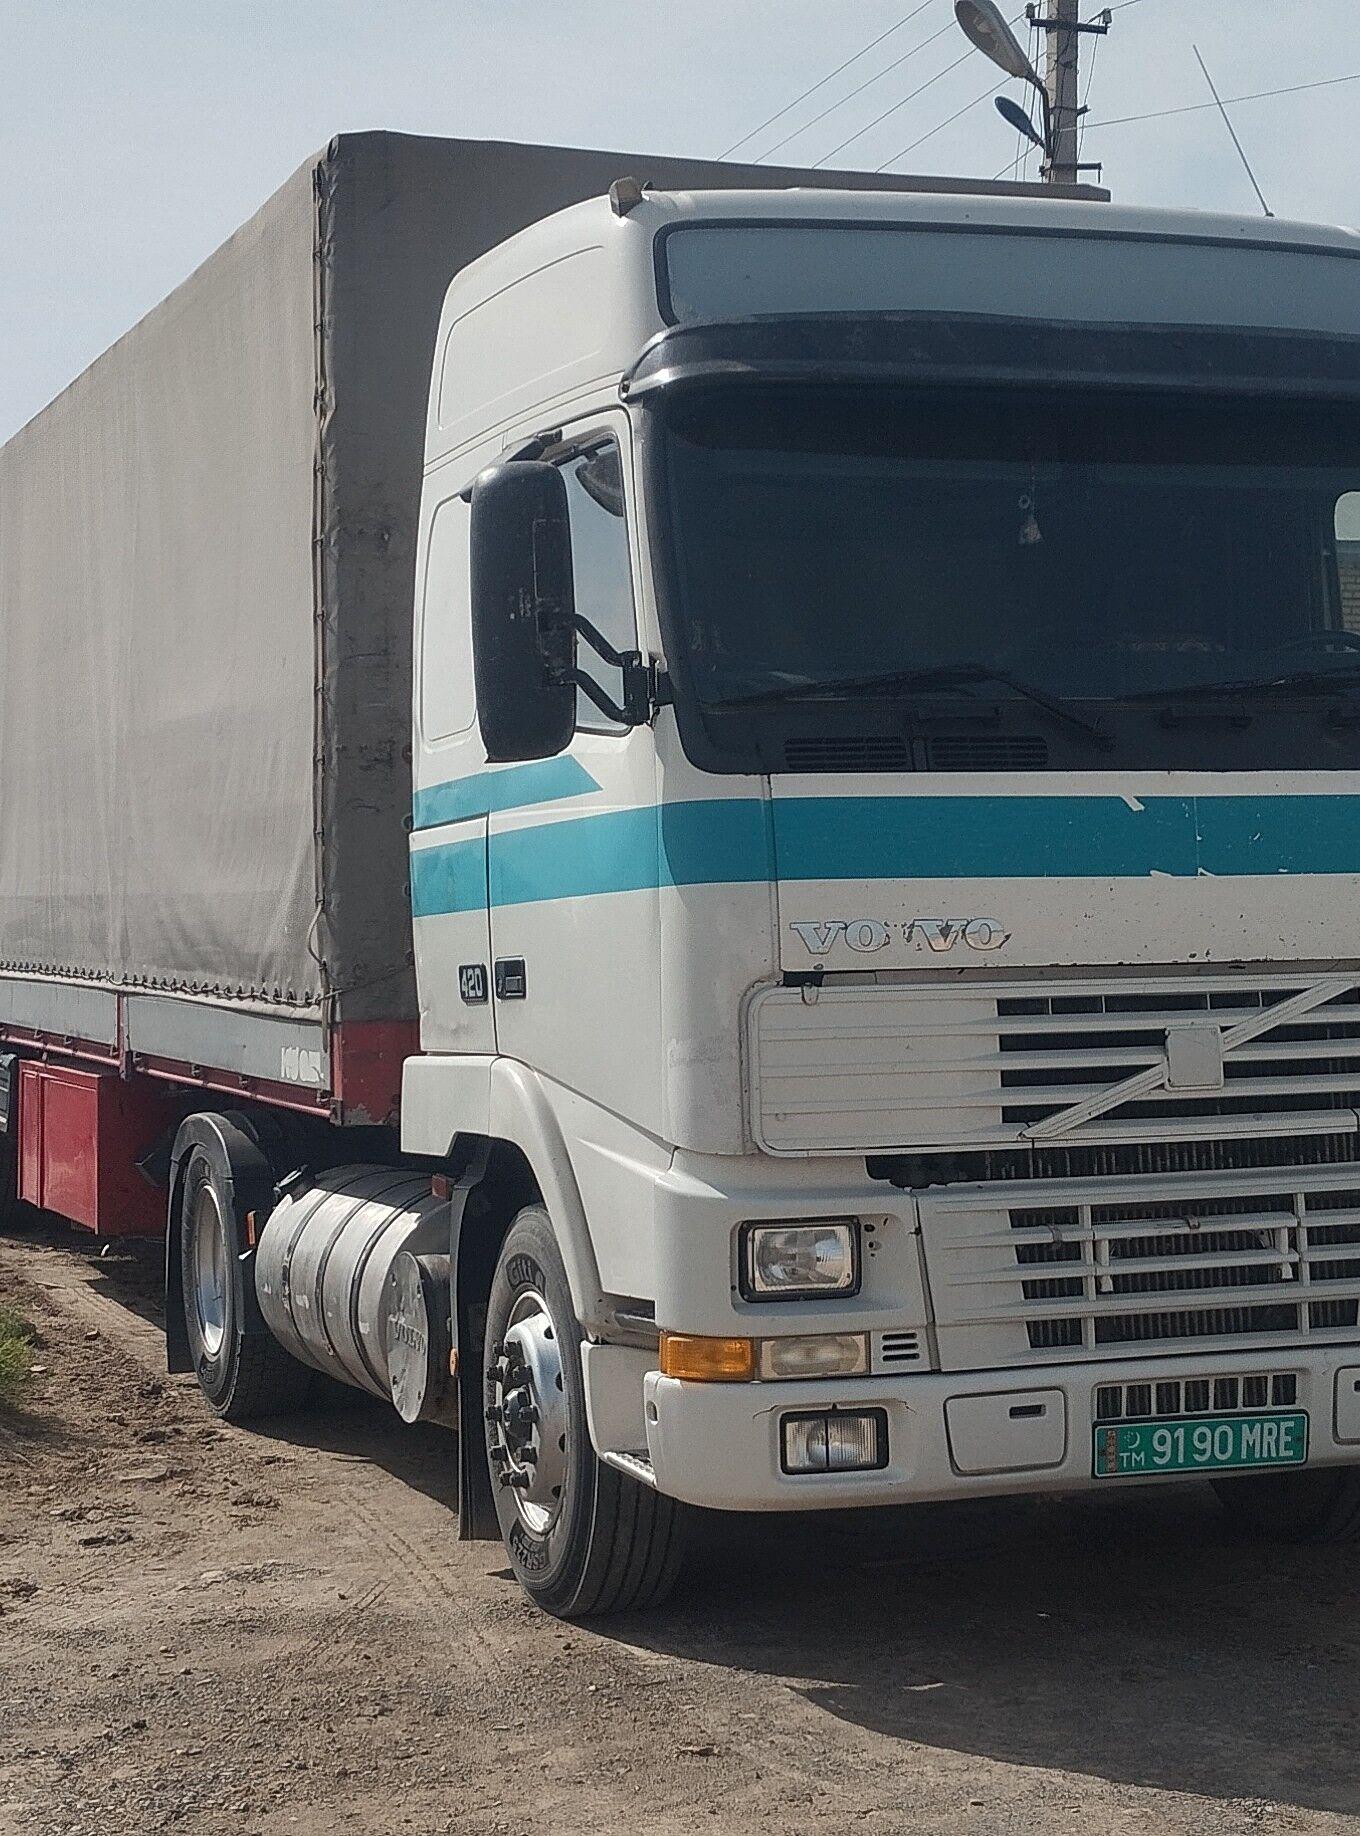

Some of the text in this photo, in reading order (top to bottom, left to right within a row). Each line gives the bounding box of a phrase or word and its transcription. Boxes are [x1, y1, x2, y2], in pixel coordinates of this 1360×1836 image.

[790, 917, 1011, 954] VOVO
[461, 967, 483, 997] 420
[1241, 1421, 1295, 1459] MRE
[1119, 1452, 1145, 1467] TM
